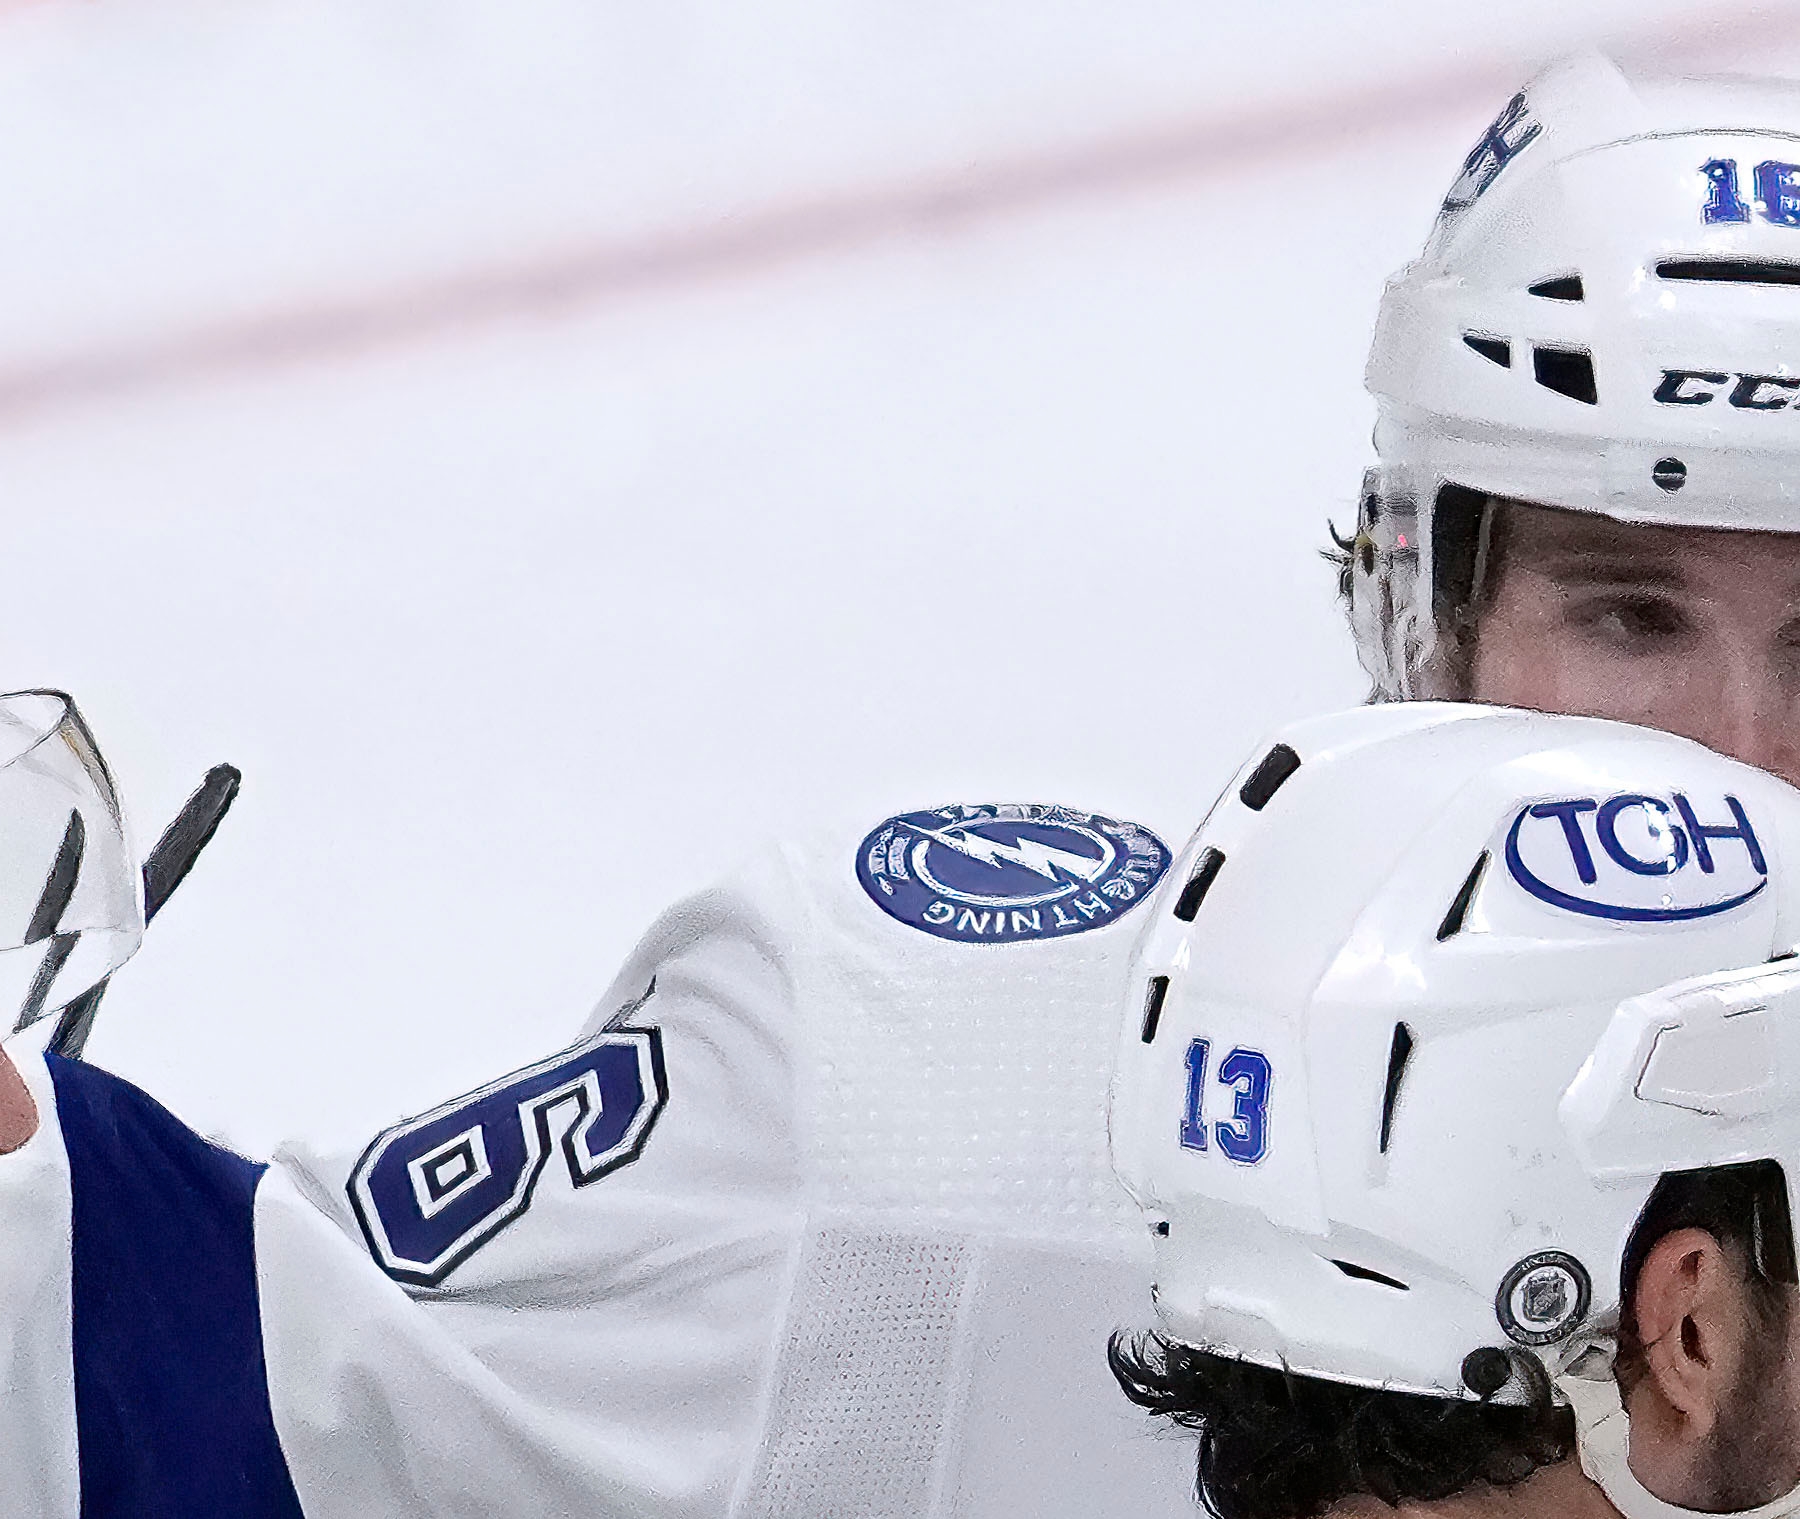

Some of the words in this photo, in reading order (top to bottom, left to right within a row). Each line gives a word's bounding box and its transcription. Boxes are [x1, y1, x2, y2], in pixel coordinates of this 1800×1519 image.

[1528, 791, 1769, 886] TGH
[344, 1018, 670, 1290] 6
[1179, 1036, 1273, 1165] 13
